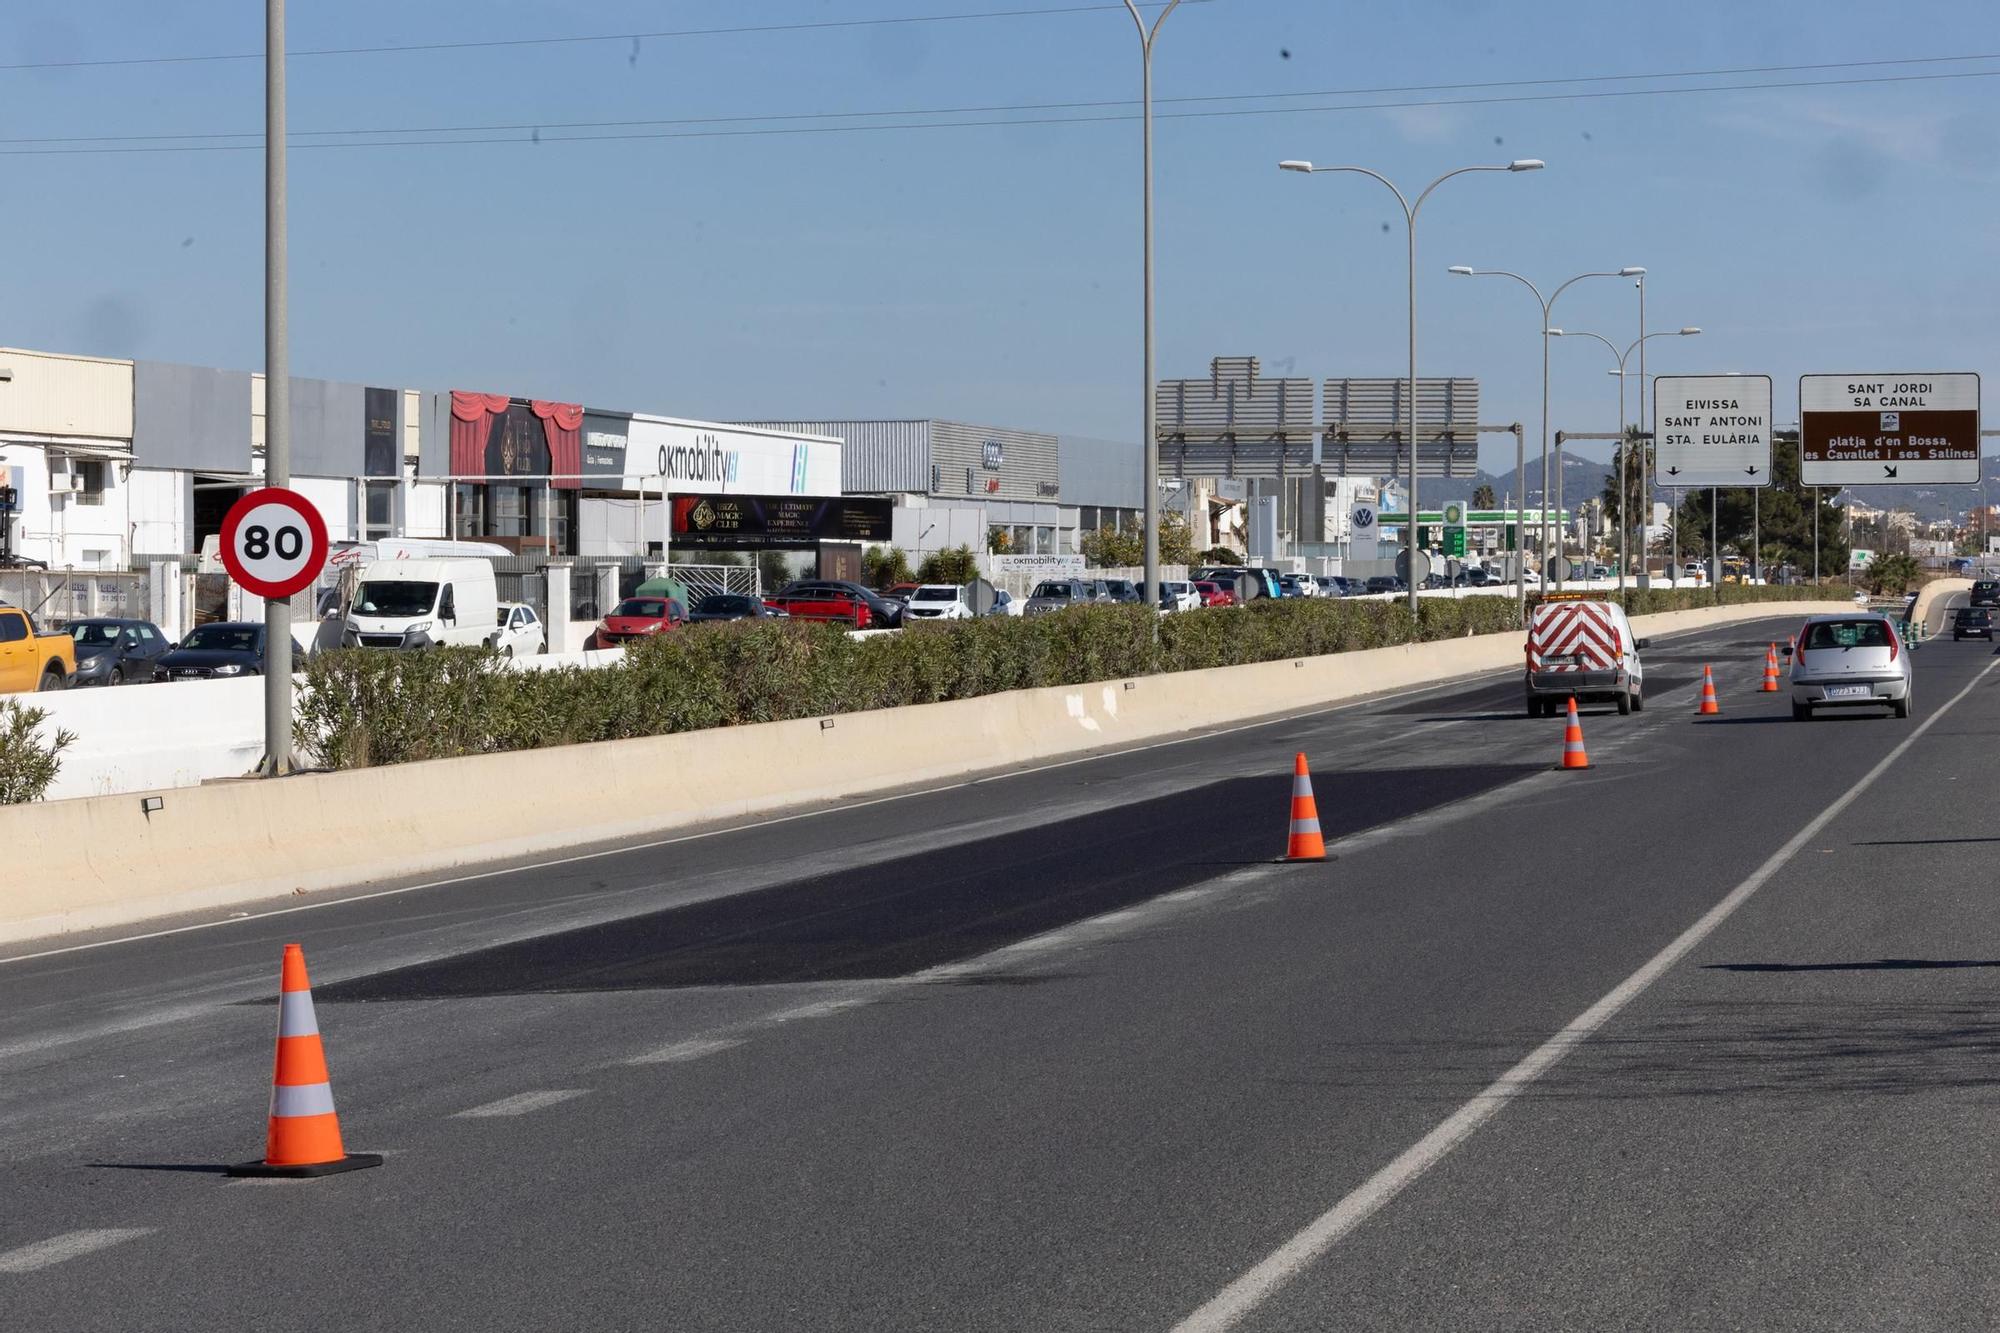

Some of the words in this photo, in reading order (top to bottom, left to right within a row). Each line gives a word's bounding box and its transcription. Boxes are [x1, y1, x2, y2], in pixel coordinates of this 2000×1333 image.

[1848, 383, 1885, 394] SANT
[1893, 383, 1932, 394] JORDI
[1686, 399, 1739, 410] EIVISSA
[1854, 397, 1872, 407] SA
[1880, 397, 1926, 407] CANAL
[1665, 416, 1701, 427] SANT
[1709, 416, 1762, 427] ANTONI
[1666, 434, 1696, 445] STA.
[1703, 432, 1760, 445] EULÀRIA
[1829, 436, 1866, 449] platja
[1874, 436, 1901, 446] d'en
[1805, 451, 1819, 460] es
[1827, 449, 1880, 460] Cavallet
[1898, 451, 1920, 459] ses
[1929, 448, 1976, 459] Salines
[658, 434, 729, 493] okmobility
[716, 511, 743, 520] MAGIC
[244, 525, 303, 560] 80
